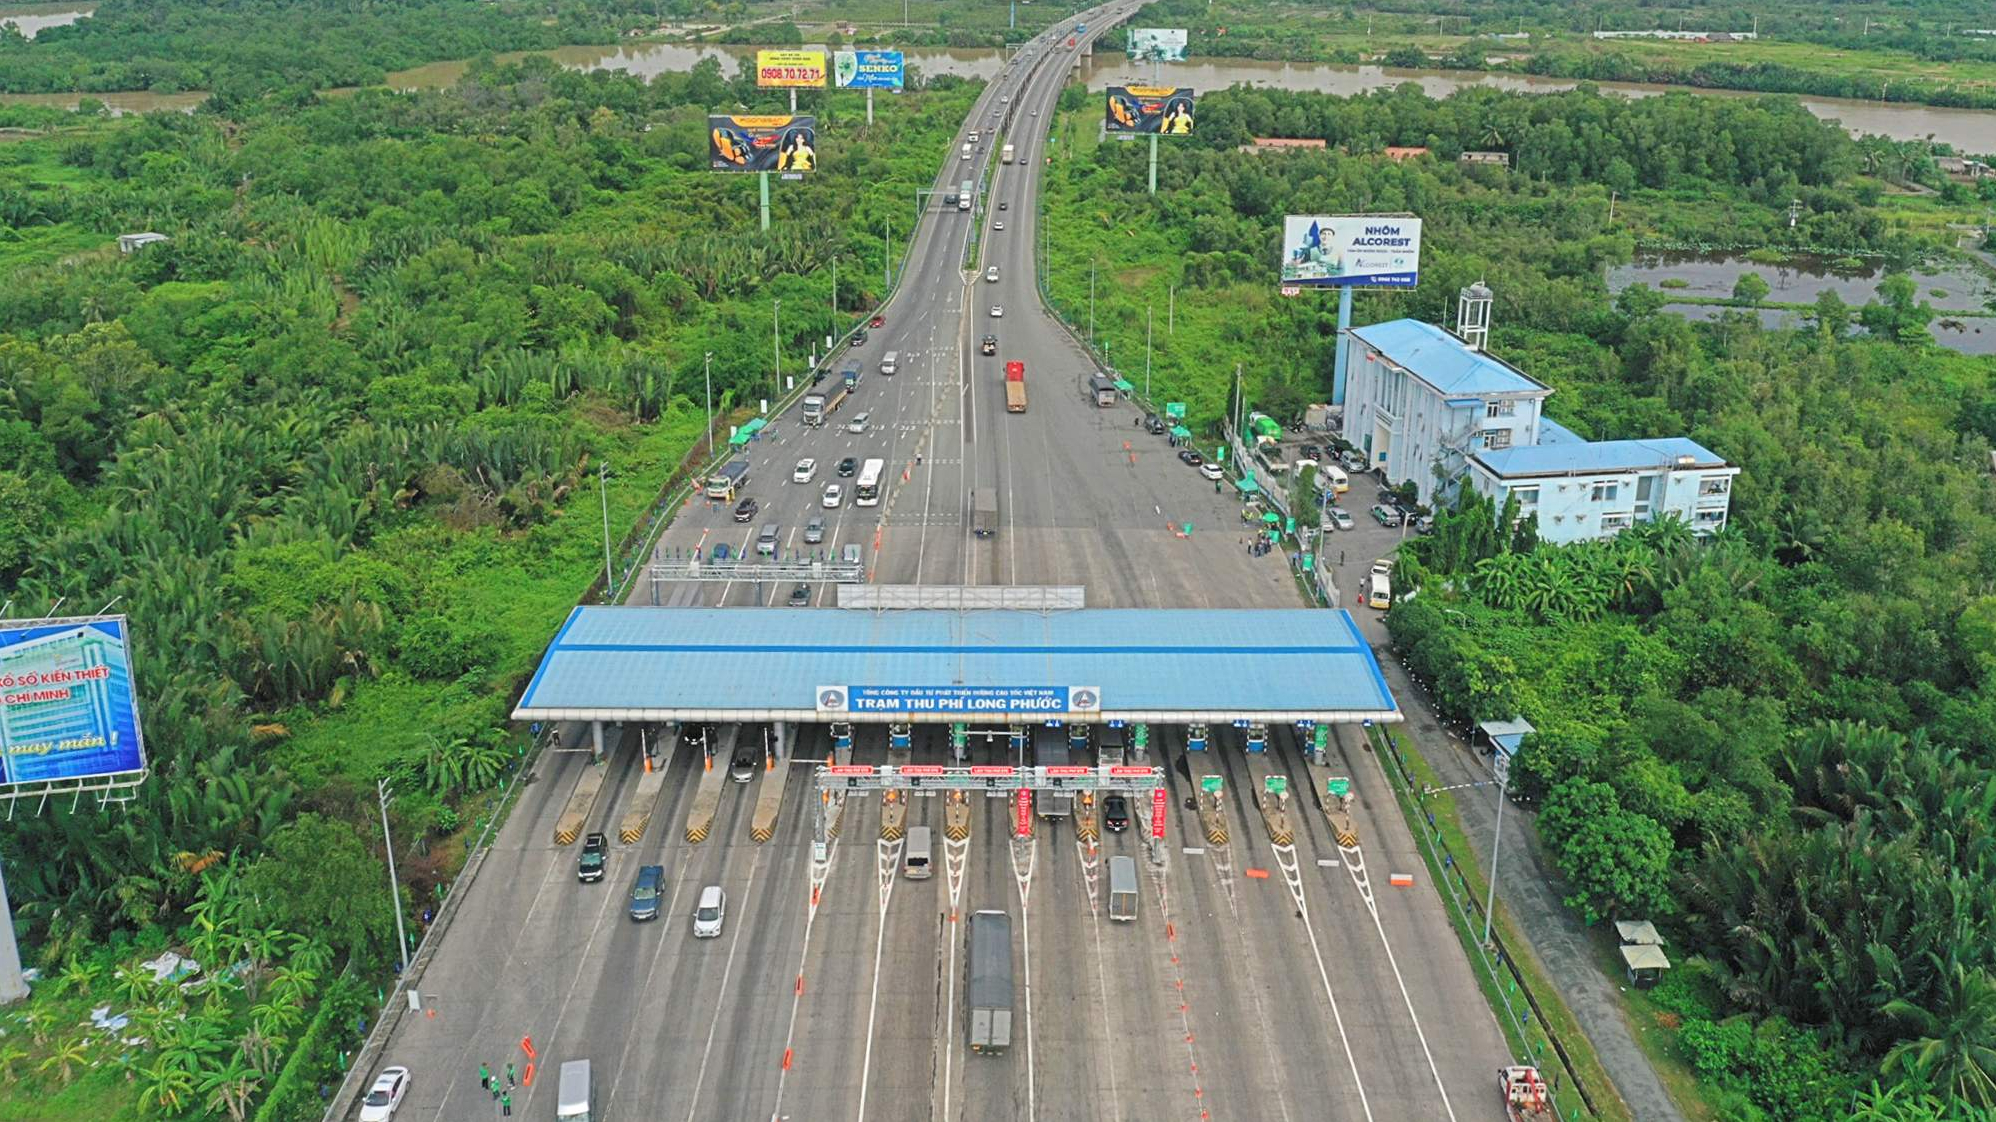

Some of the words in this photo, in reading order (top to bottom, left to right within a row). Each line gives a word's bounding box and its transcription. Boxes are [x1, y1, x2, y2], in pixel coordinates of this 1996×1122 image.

[761, 68, 820, 79] 0908.70.72.71
[858, 64, 898, 72] SENKO
[1365, 224, 1400, 236] NHÔM
[1352, 238, 1411, 246] ALCOREST
[18, 670, 38, 686] SỐ
[41, 667, 72, 684] KIẾN
[74, 664, 109, 680] THIẾT
[34, 689, 70, 701] MINH
[855, 698, 900, 710] TRẠM
[904, 698, 934, 709] THU
[938, 696, 964, 709] PHÍ
[967, 698, 1006, 710] LONG
[1010, 696, 1062, 710] PHƯỚC
[9, 741, 53, 755] may
